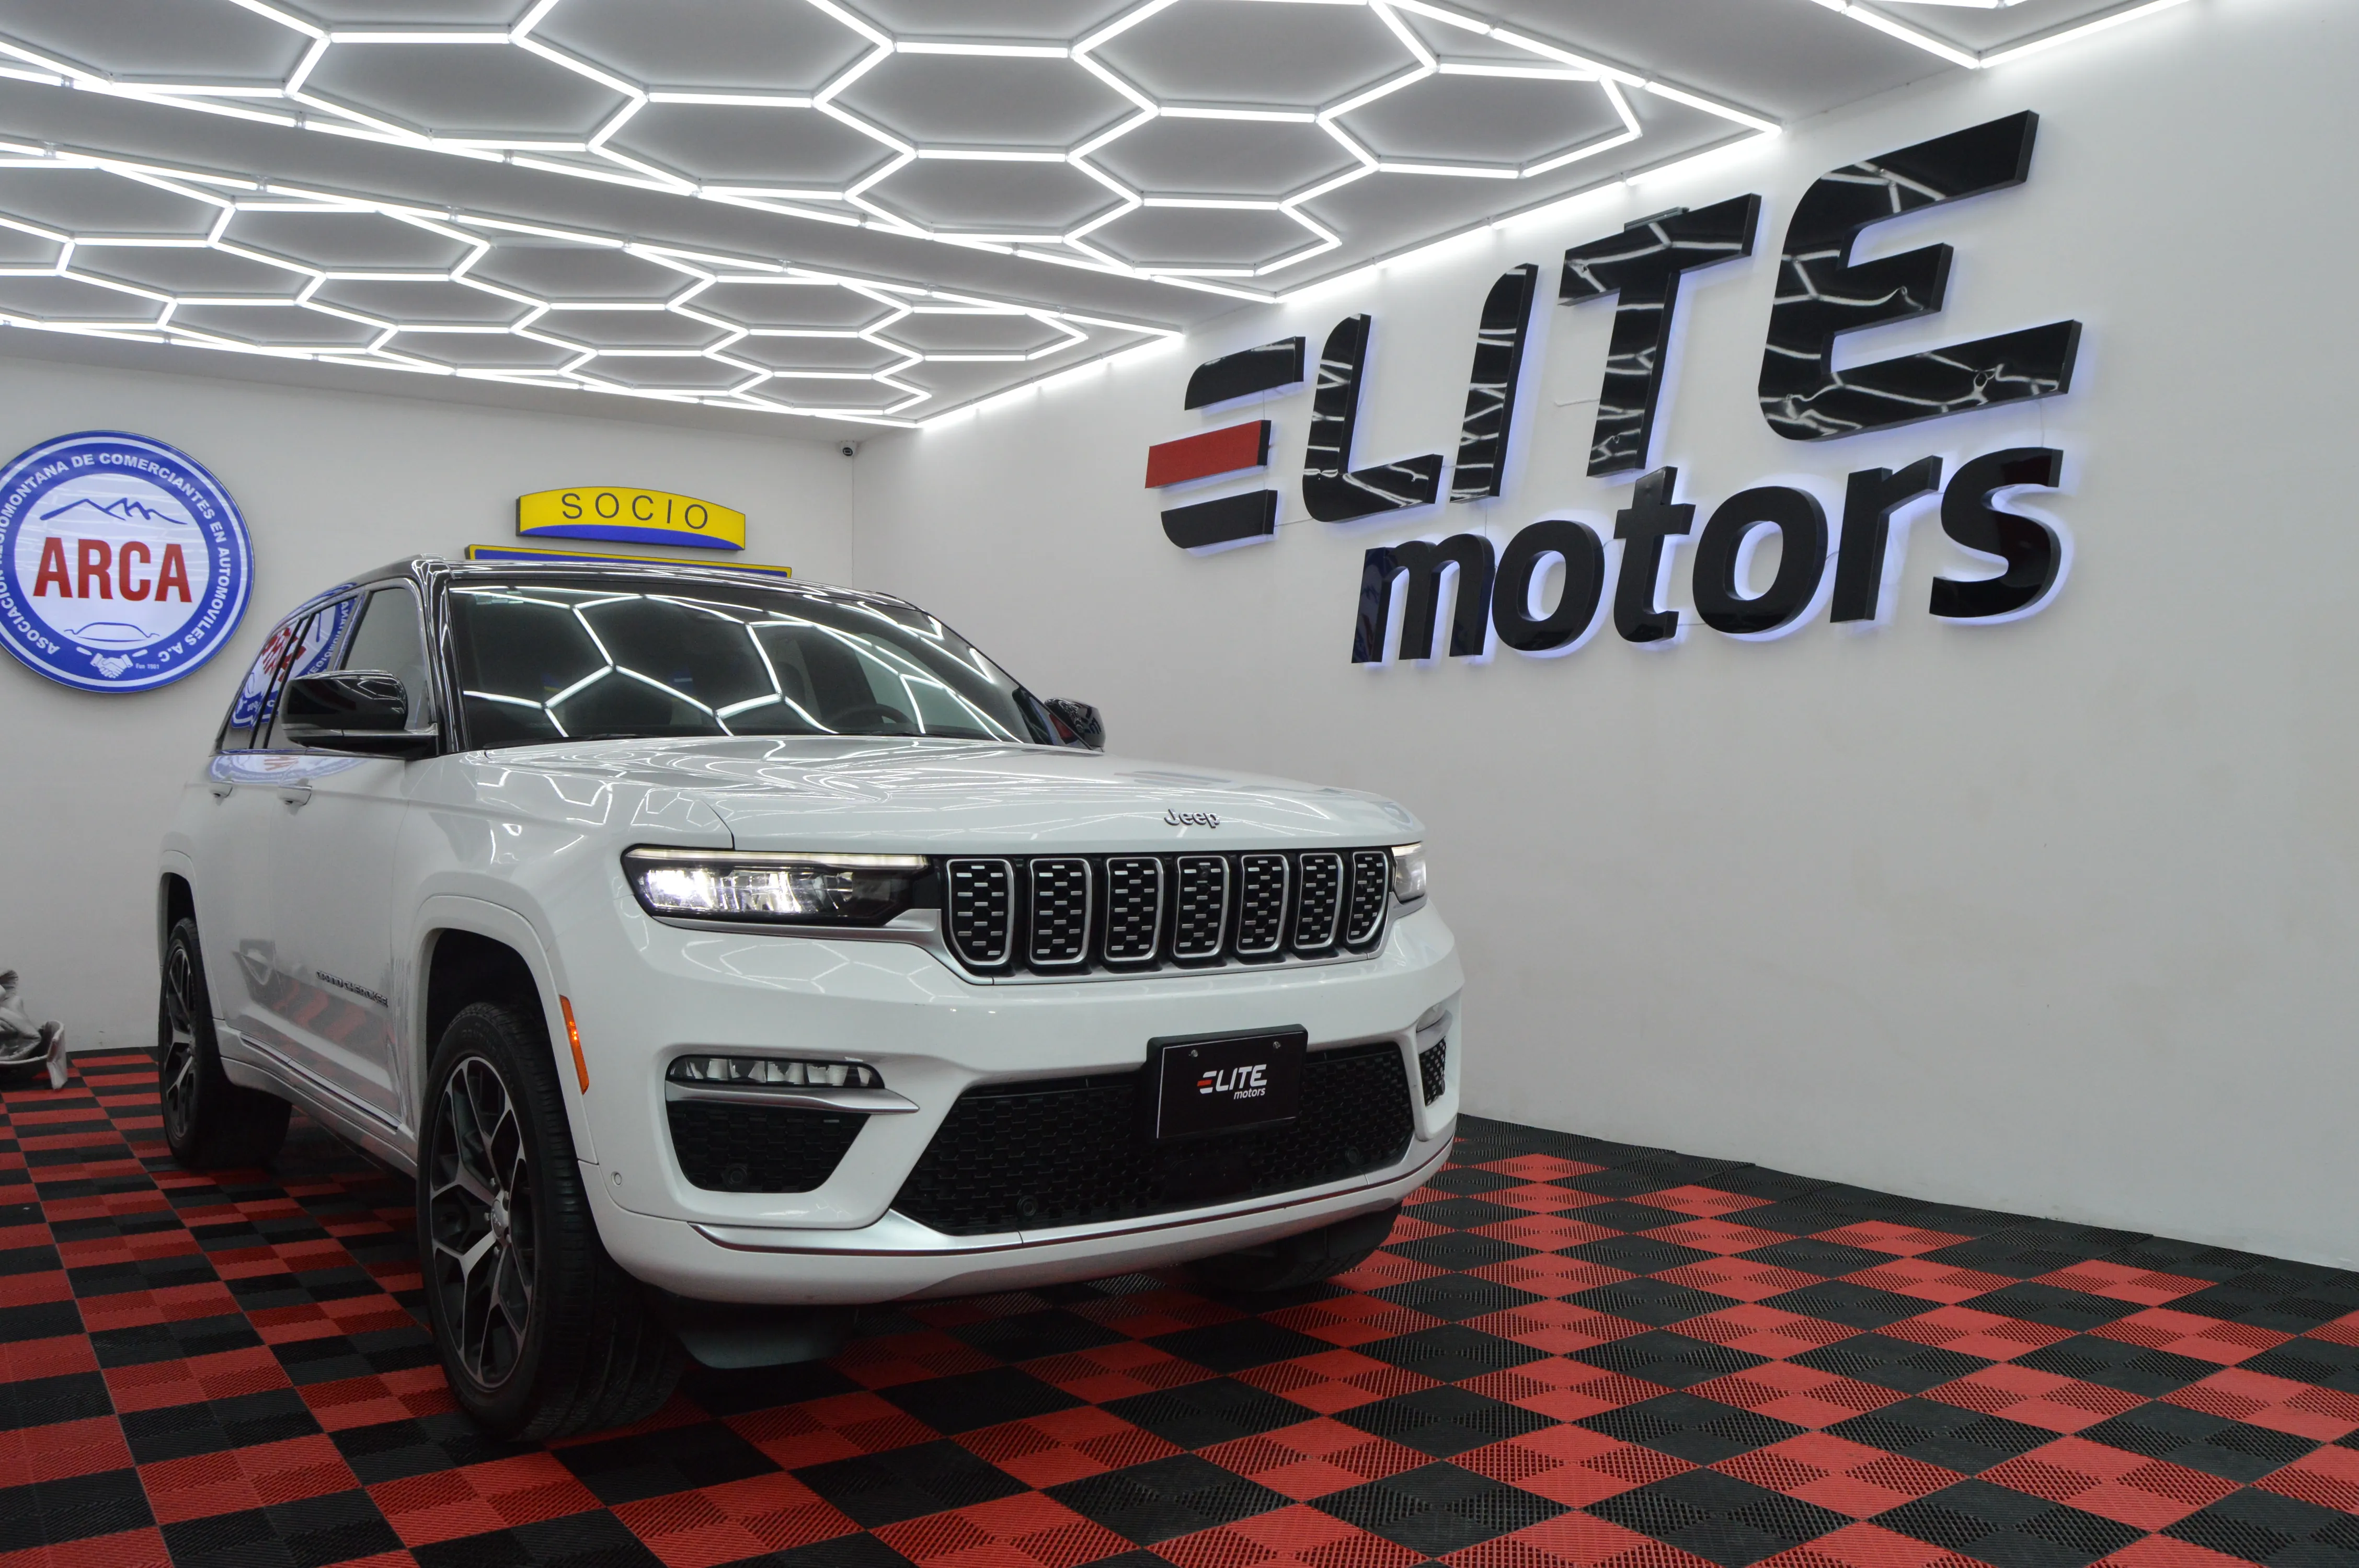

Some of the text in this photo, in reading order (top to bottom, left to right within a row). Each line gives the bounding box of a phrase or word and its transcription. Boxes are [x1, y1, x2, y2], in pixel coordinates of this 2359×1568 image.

[1144, 109, 2082, 549] ELITE
[71, 454, 95, 468] DE
[99, 453, 215, 520] COMERCIANTES
[0, 461, 69, 564] IOMONTANA
[210, 521, 227, 543] EN
[561, 492, 708, 529] SOCIO
[33, 536, 192, 603] ARCA
[1351, 446, 2064, 664] motors
[185, 547, 231, 645] AUTOMOVILES
[1164, 809, 1220, 828] Jeep
[1197, 1064, 1267, 1094] ELITE
[1233, 1088, 1266, 1100] motors
